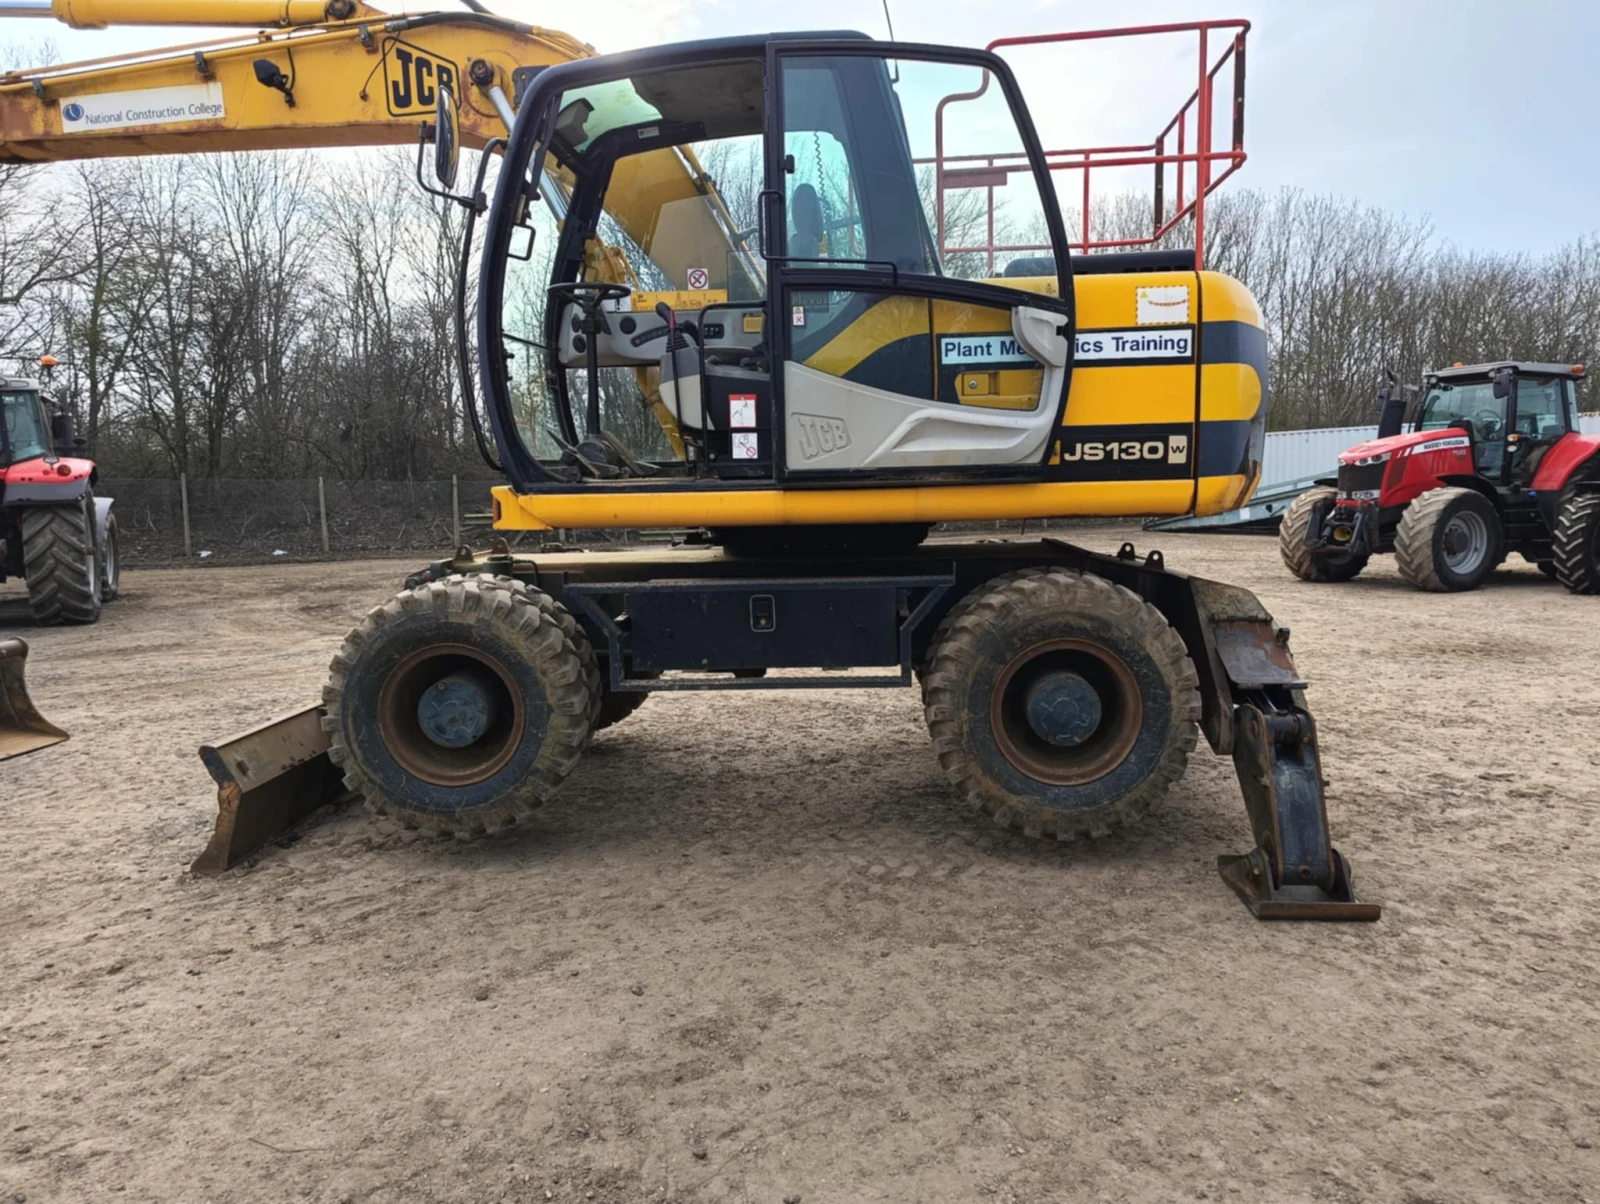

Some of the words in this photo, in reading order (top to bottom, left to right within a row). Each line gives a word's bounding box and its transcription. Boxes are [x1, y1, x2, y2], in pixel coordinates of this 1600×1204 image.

[392, 47, 454, 108] JCB
[85, 110, 123, 125] National
[126, 105, 185, 122] Construction
[188, 102, 223, 117] College
[944, 340, 993, 358] Plant
[1111, 335, 1189, 355] Training
[798, 417, 849, 460] JCB
[1063, 440, 1165, 461] JS130
